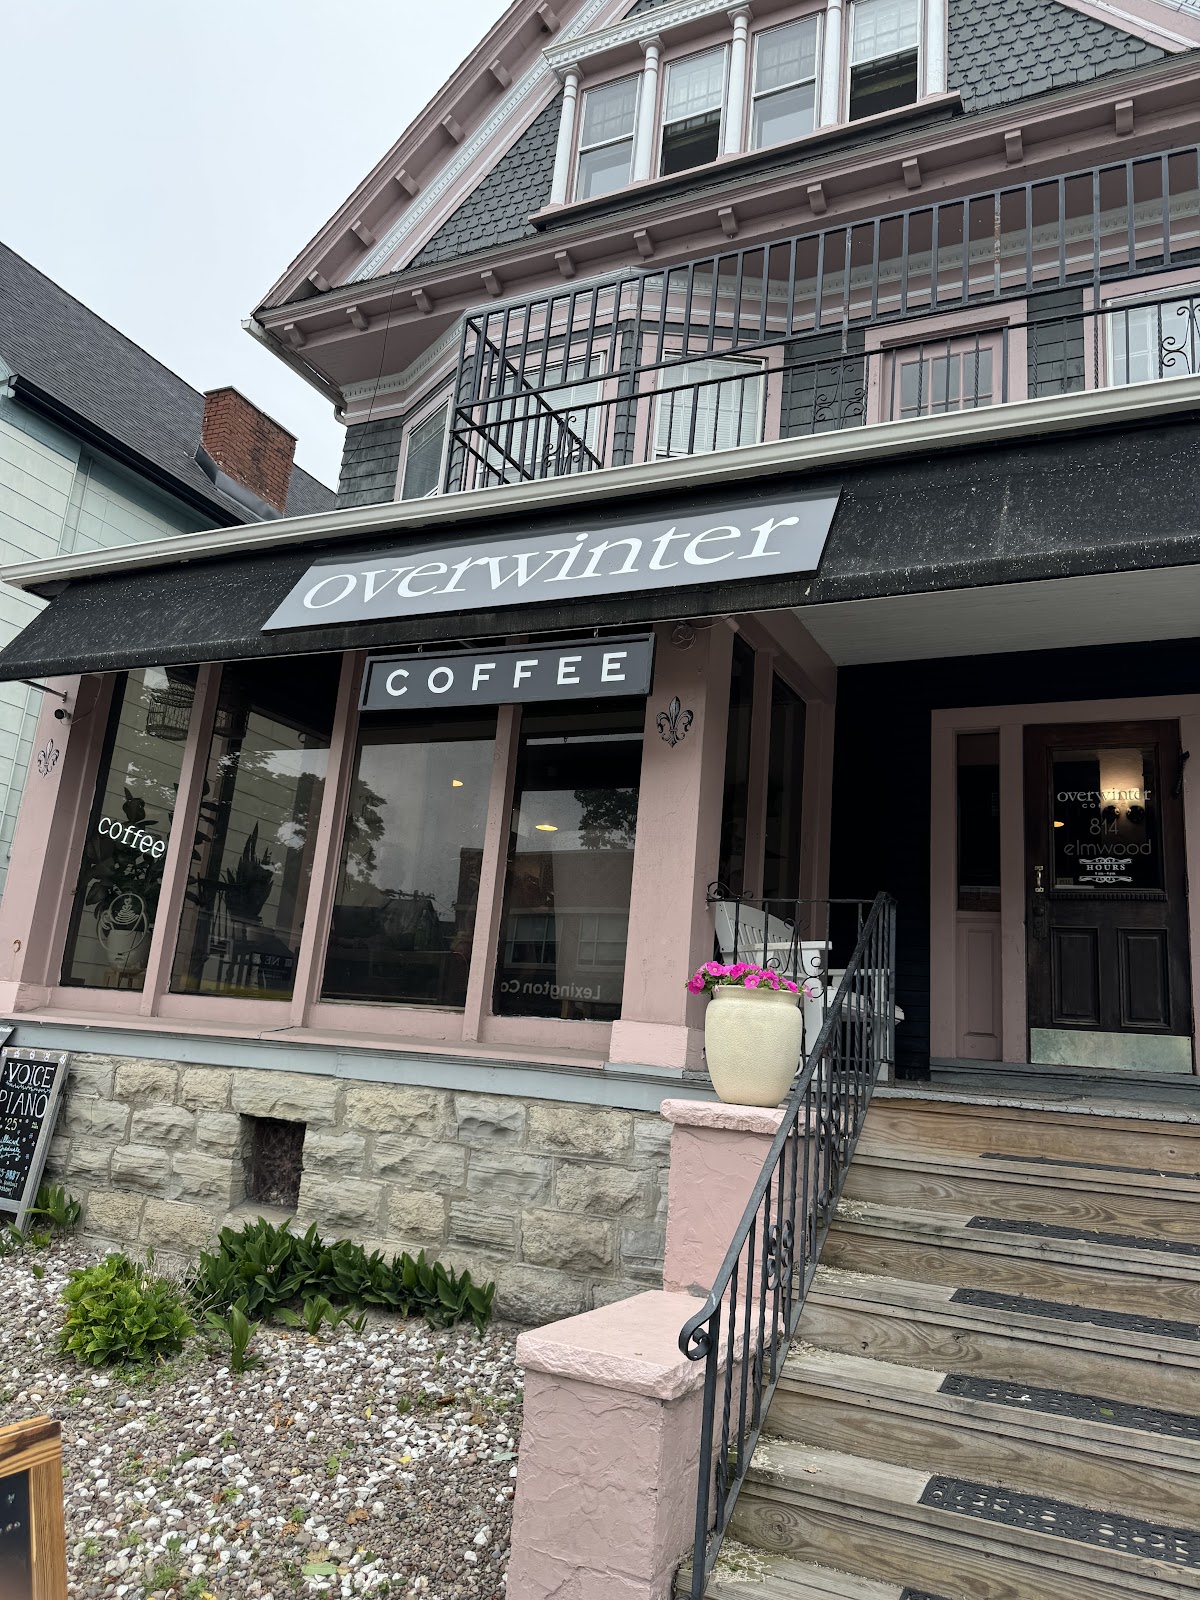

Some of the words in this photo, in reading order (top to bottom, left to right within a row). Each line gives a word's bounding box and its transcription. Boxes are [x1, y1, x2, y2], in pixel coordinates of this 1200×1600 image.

[303, 515, 800, 610] overwinter
[385, 651, 628, 696] COFFEE
[1057, 788, 1152, 802] overwinter
[1089, 817, 1119, 835] 814
[98, 817, 166, 859] coffee
[1063, 839, 1152, 856] elmwood
[1086, 863, 1126, 871] HOURS
[7, 1062, 55, 1088] VOICE
